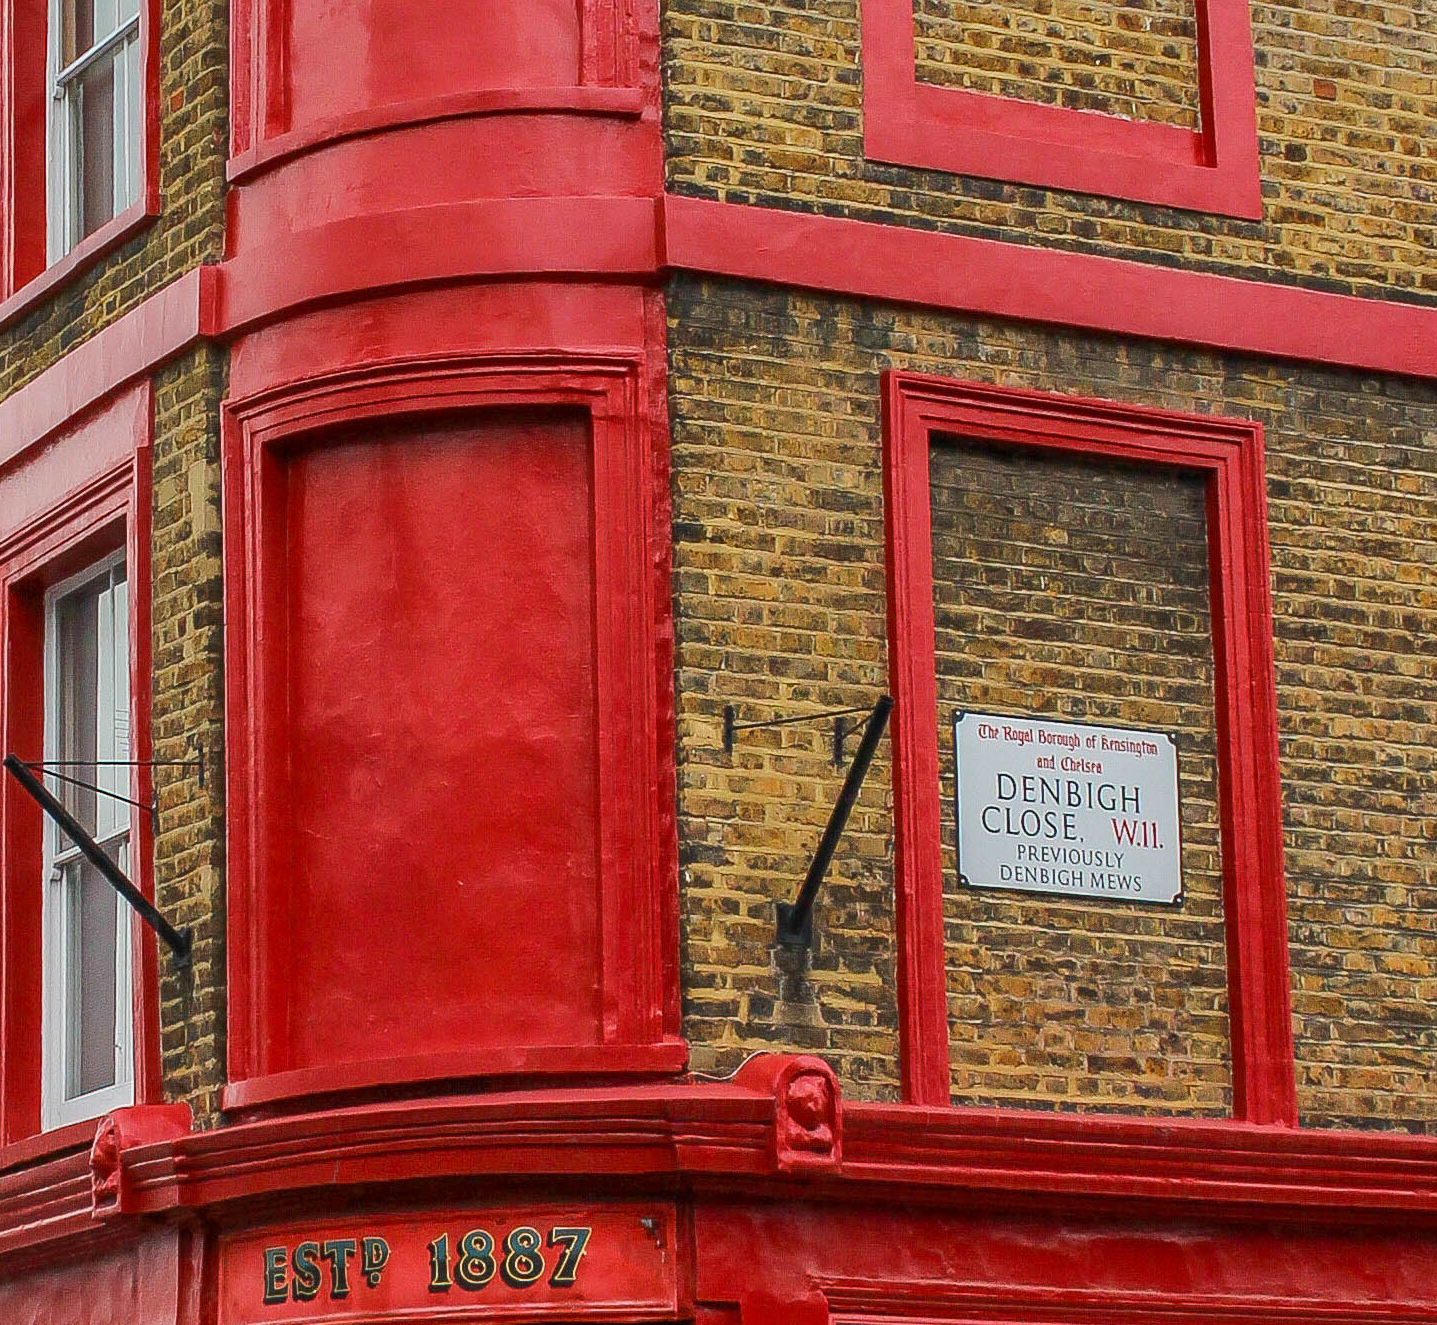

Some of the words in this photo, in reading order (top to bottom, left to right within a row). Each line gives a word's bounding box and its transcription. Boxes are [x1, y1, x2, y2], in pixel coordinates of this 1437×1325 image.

[978, 724, 998, 740] The
[1002, 725, 1034, 747] Royal
[1038, 729, 1081, 751] Borough
[1086, 735, 1098, 749] of
[1101, 735, 1159, 758] Kensington
[1037, 755, 1056, 770] and
[1061, 757, 1103, 774] Chelsea
[996, 773, 1141, 814] DENBIGH
[1017, 844, 1125, 869] PREVIOUSLY
[1000, 864, 1084, 888] DENBIGH
[1090, 872, 1142, 892] MEWS
[427, 1226, 592, 1291] 1887
